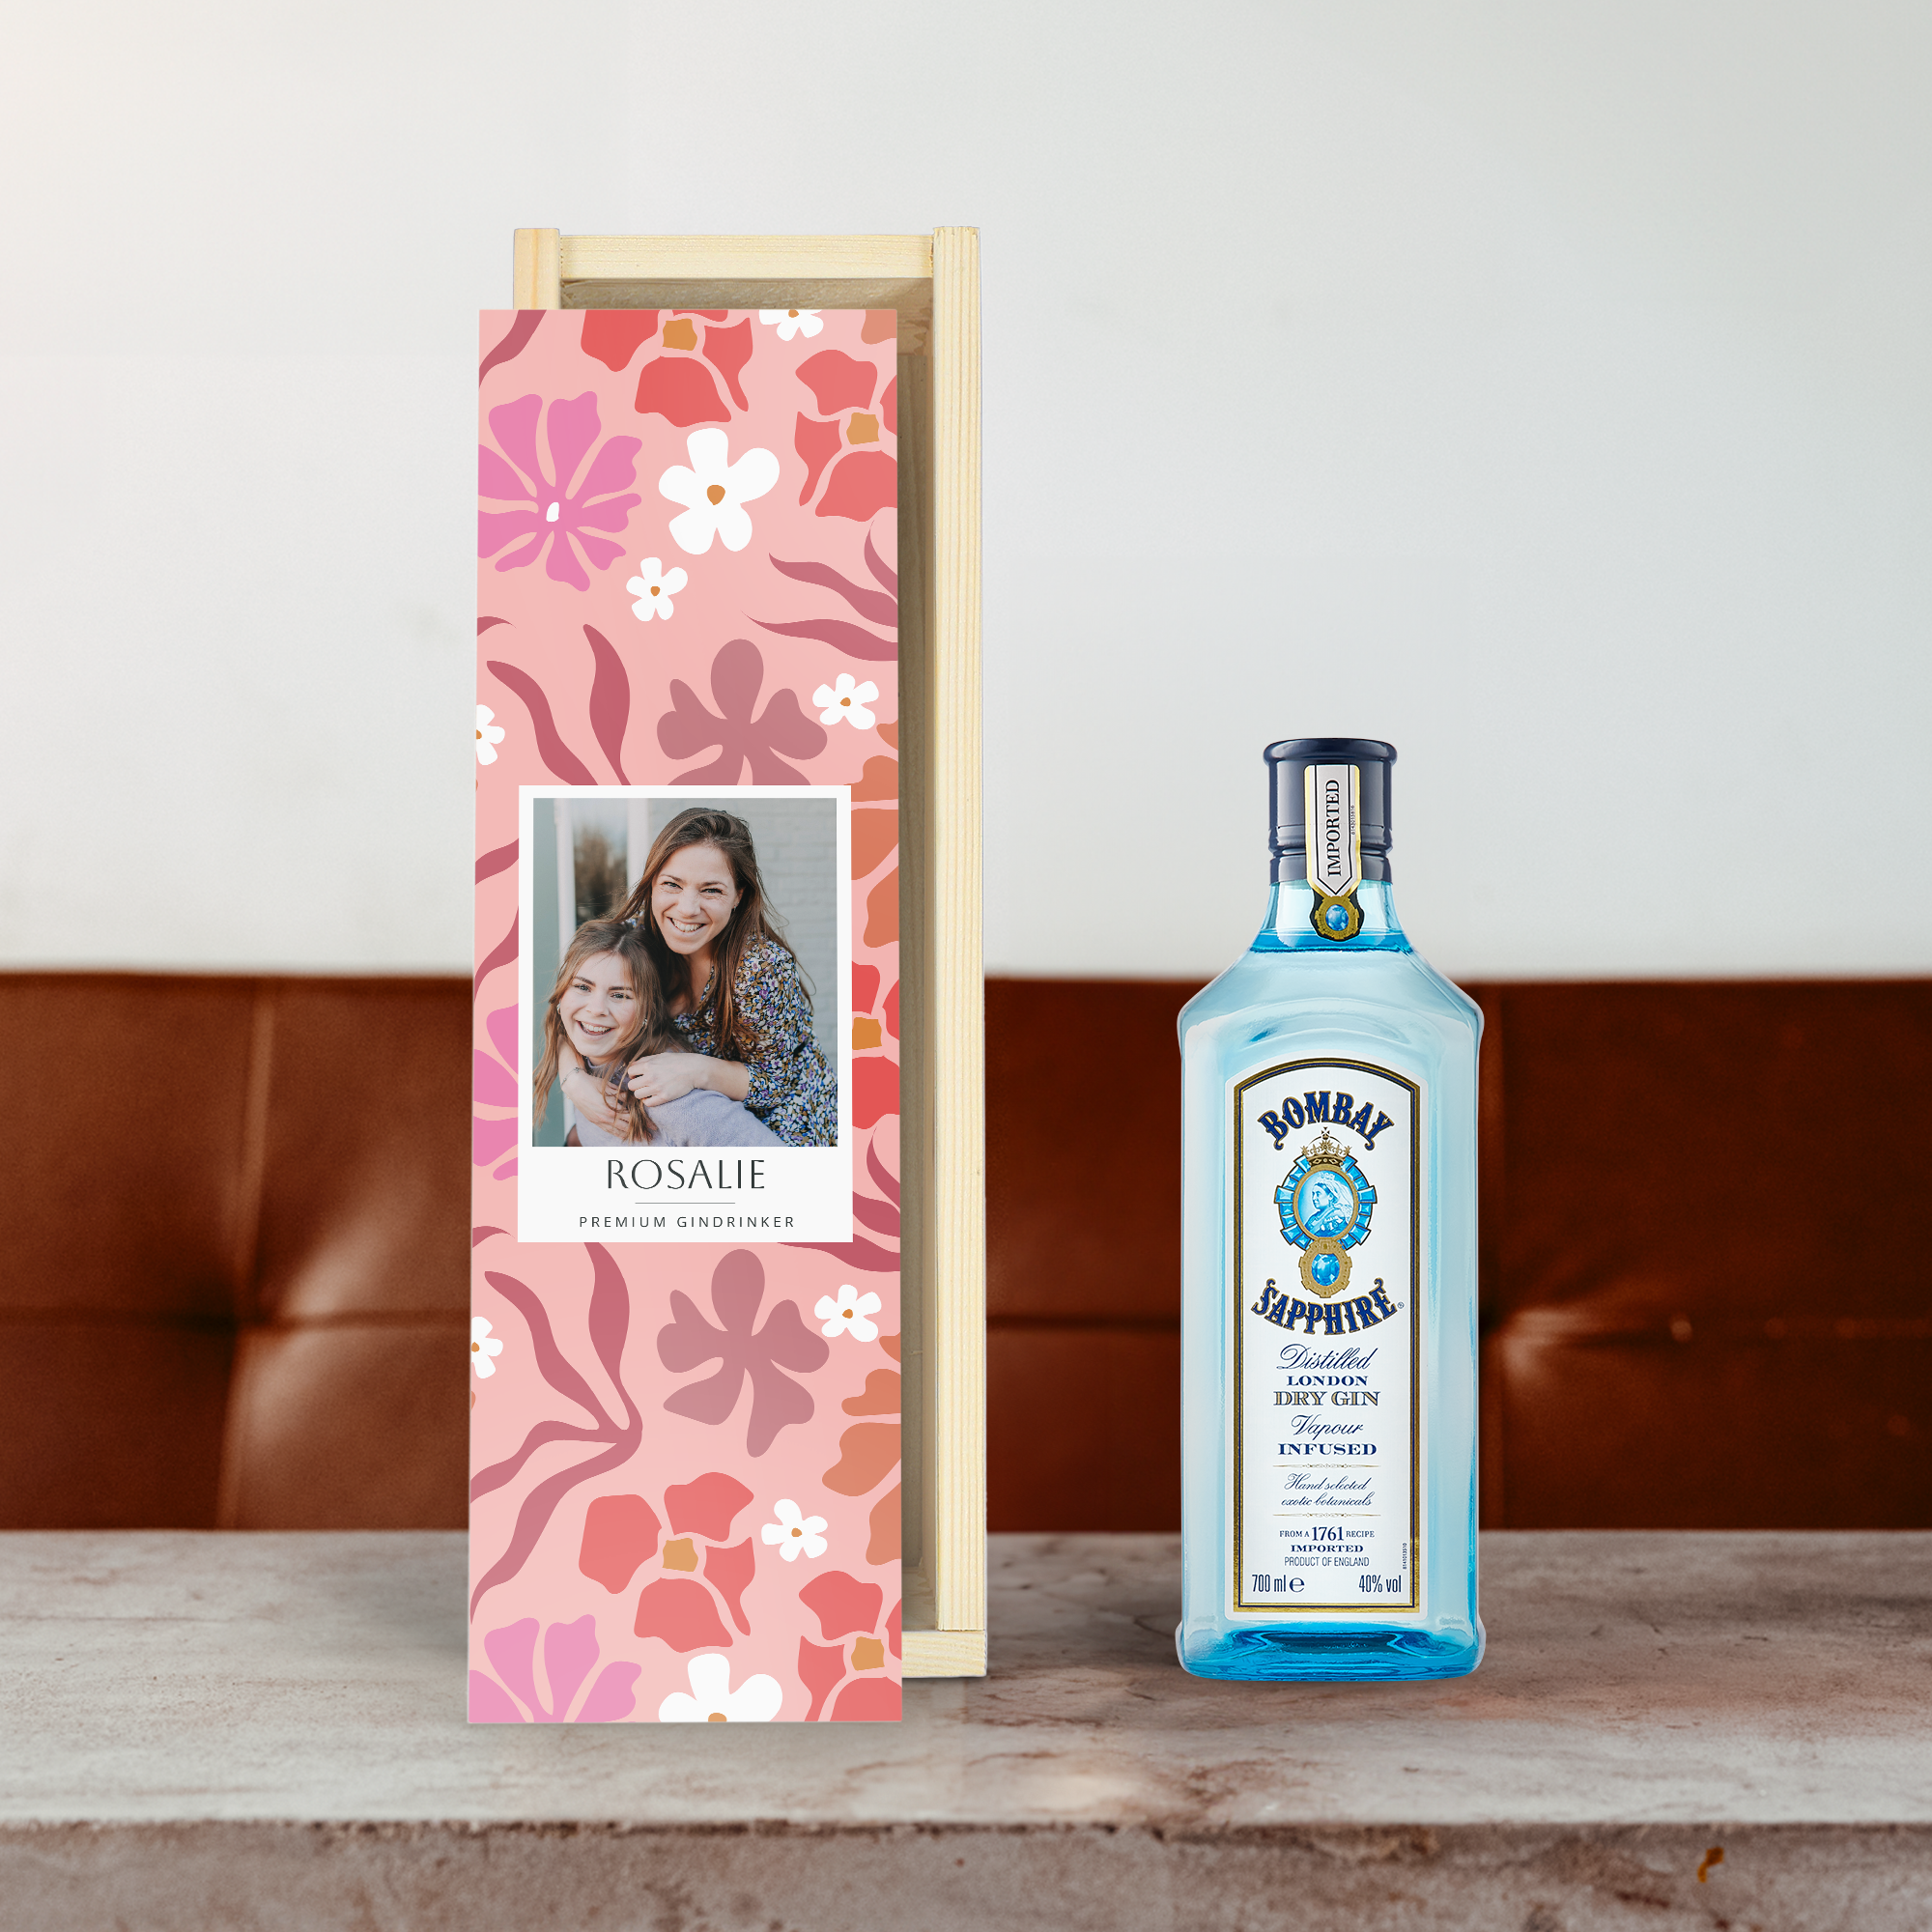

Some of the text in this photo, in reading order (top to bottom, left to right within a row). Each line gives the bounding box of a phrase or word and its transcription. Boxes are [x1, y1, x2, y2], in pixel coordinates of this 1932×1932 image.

[1325, 780, 1342, 877] IMPORTED
[1257, 1091, 1395, 1151] BOMBAY
[608, 1159, 765, 1189] ROSALIE
[580, 1216, 794, 1228] PREMIUM GINDRINKER
[1276, 1344, 1378, 1370] Distilled
[1287, 1376, 1368, 1386] LONDON
[1273, 1391, 1380, 1406] DRY GIN
[1292, 1414, 1363, 1440] Vapour
[1278, 1443, 1377, 1455] INFUSED
[1284, 1473, 1372, 1490] Hand selected
[1281, 1492, 1375, 1506] exotic botanicals
[1312, 1526, 1344, 1541] 1761
[1285, 1556, 1369, 1566] PRODUCT OF ENGLAND
[1252, 1575, 1270, 1592] 700
[1274, 1575, 1286, 1592] ml
[1359, 1575, 1401, 1593] 40% vol
